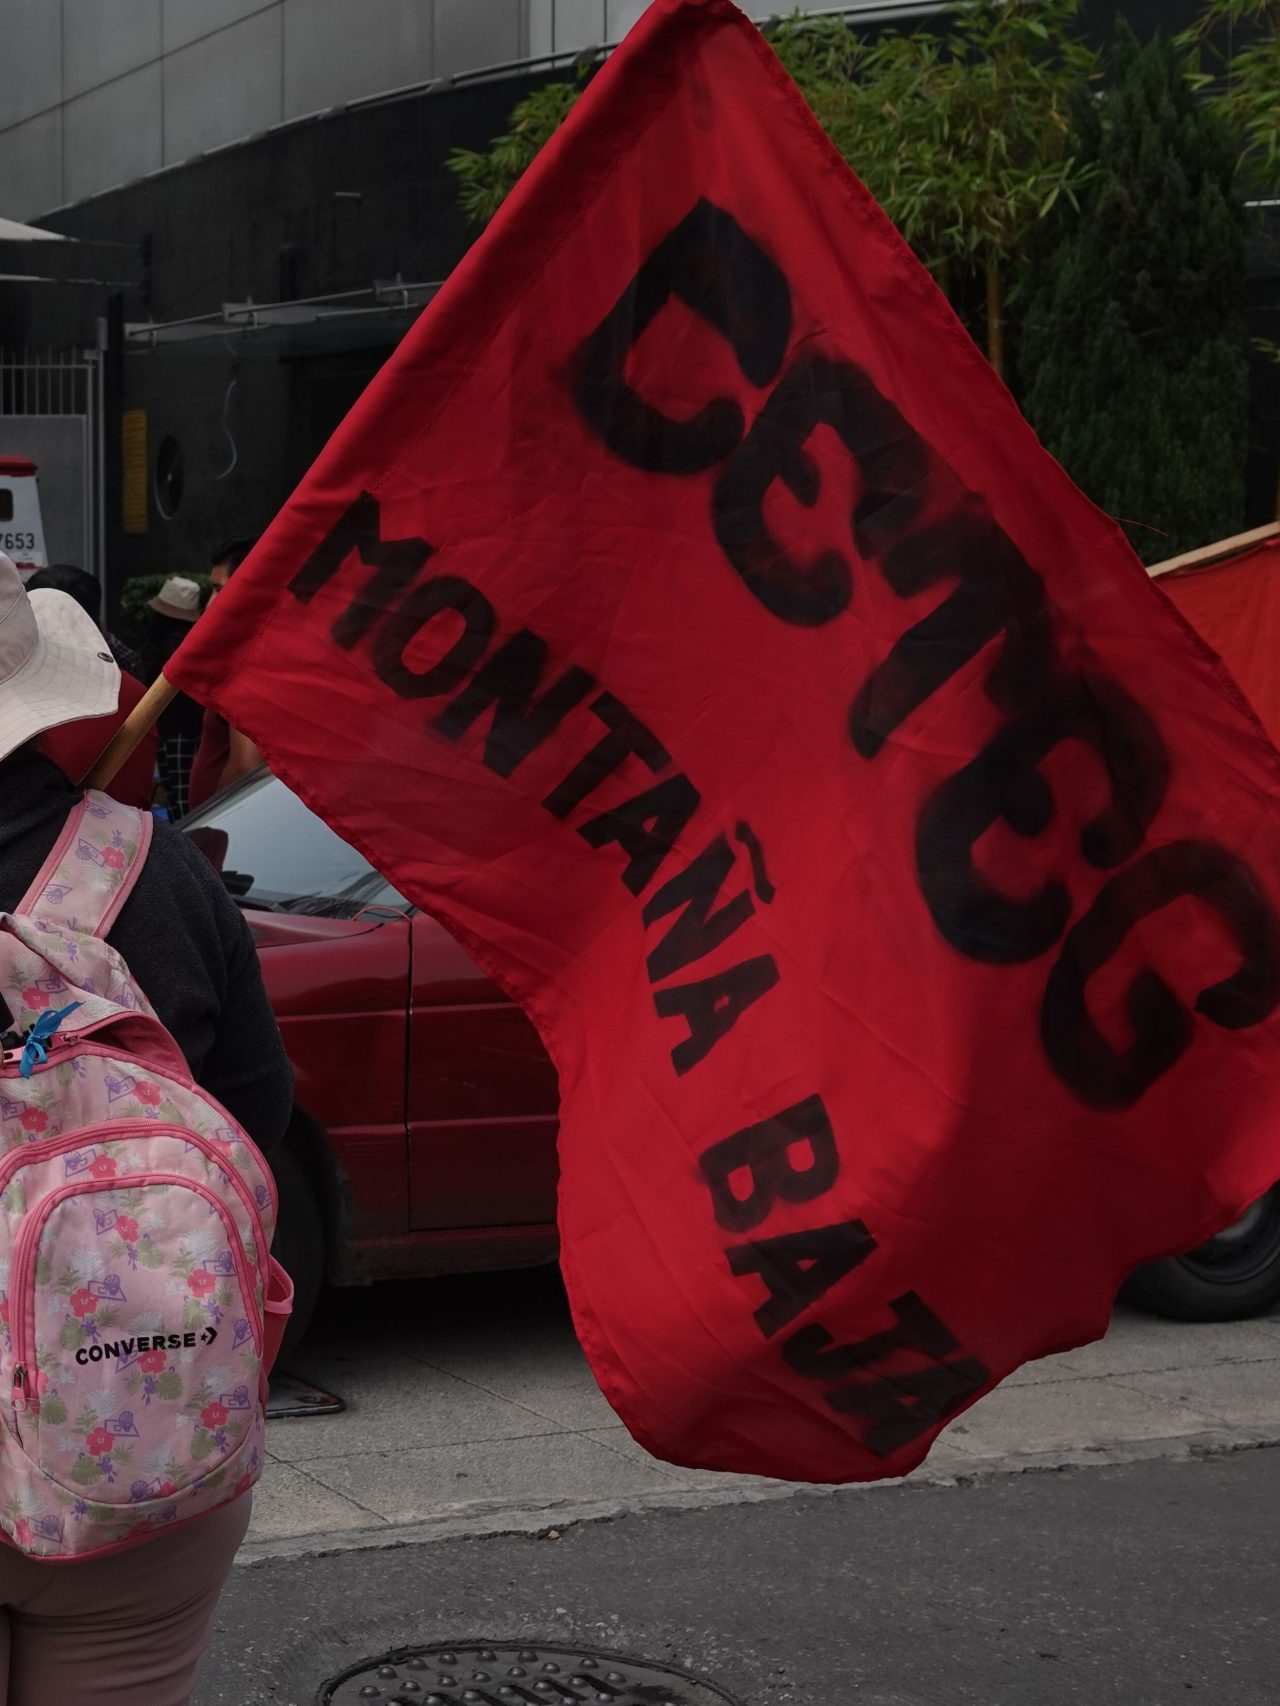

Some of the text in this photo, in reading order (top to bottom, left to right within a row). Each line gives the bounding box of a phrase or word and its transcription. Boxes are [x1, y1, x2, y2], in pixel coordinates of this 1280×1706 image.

[287, 490, 989, 1458] MONTAÑA BAJA
[75, 1332, 196, 1365] CONVERSE
